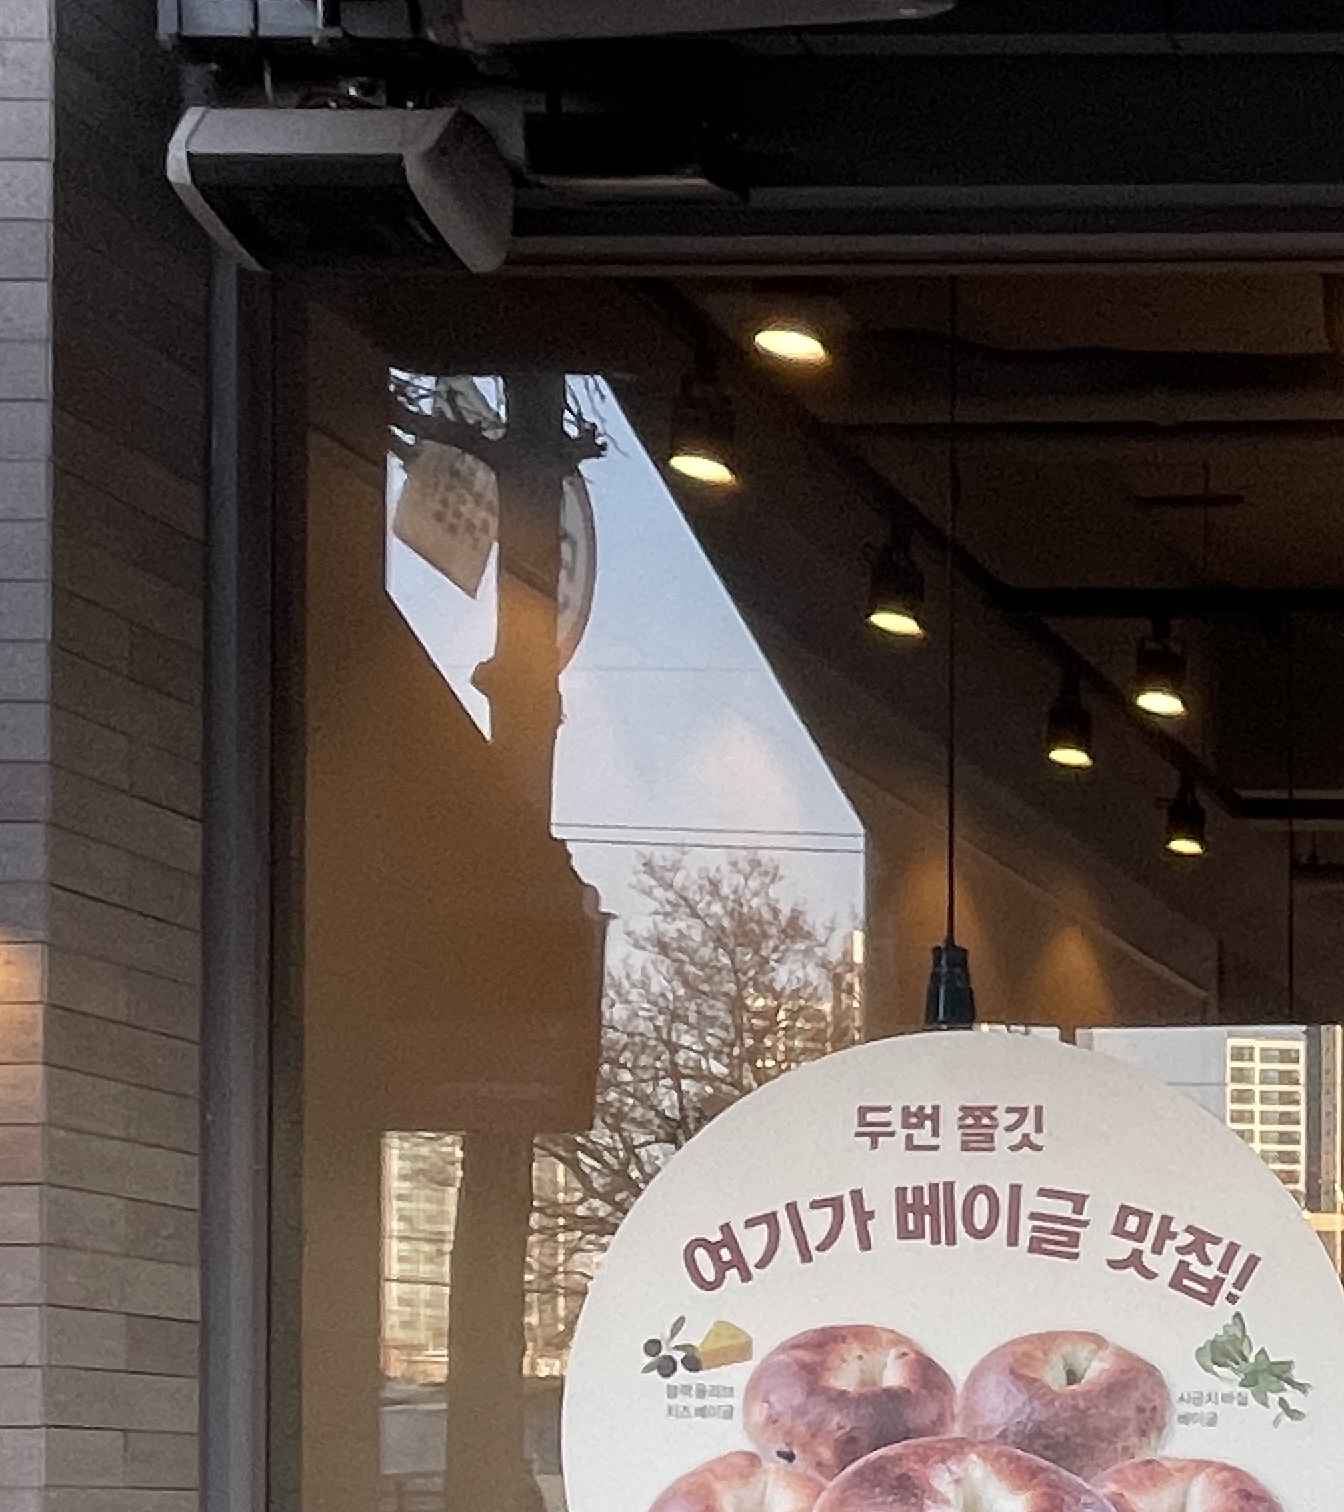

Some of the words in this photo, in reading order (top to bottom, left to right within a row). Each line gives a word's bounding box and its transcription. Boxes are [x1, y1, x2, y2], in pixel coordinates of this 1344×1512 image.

[853, 1104, 941, 1151] 두번
[956, 1104, 1047, 1152] 쫄깃
[683, 1188, 874, 1292] 여기가
[894, 1180, 1091, 1261] 베이글
[1106, 1208, 1262, 1307] 맛집!
